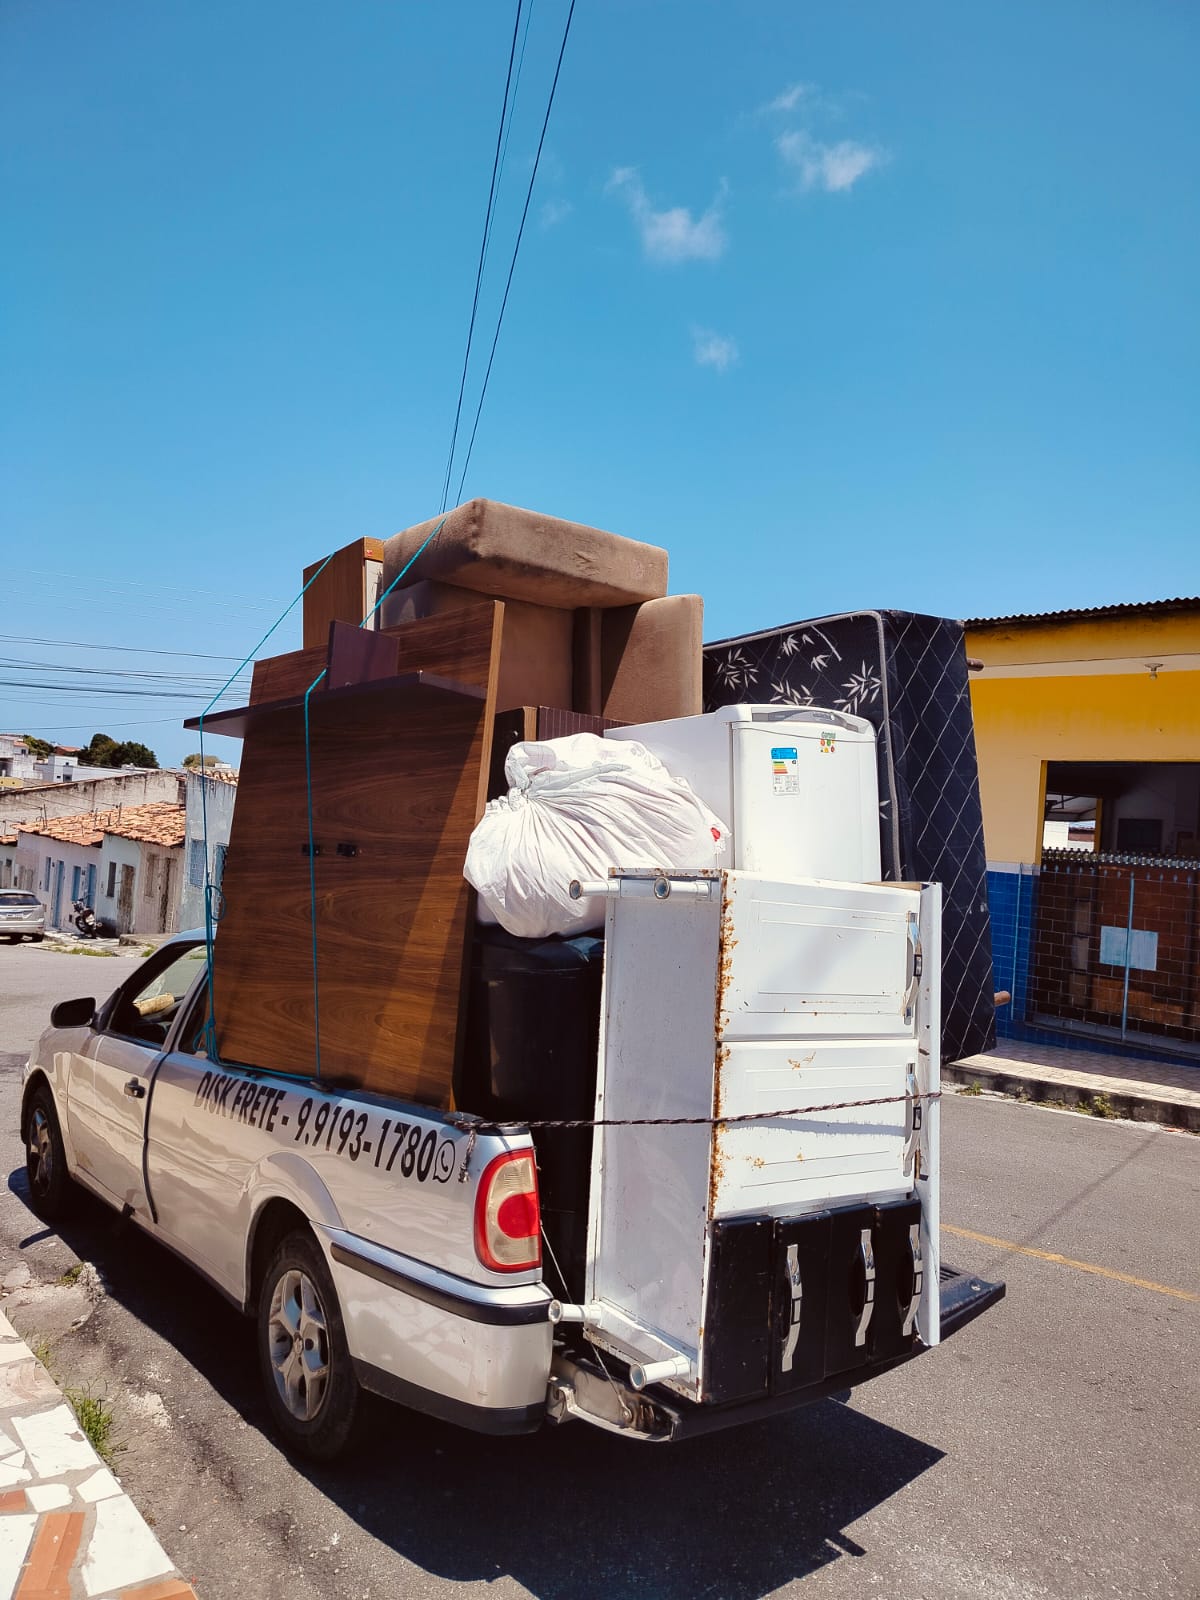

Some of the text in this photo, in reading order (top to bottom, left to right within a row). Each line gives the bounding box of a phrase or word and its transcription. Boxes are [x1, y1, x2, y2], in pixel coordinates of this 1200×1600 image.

[193, 1071, 239, 1117] DISK
[230, 1081, 288, 1132] FRETE
[295, 1098, 437, 1182] 9.9193-1780
